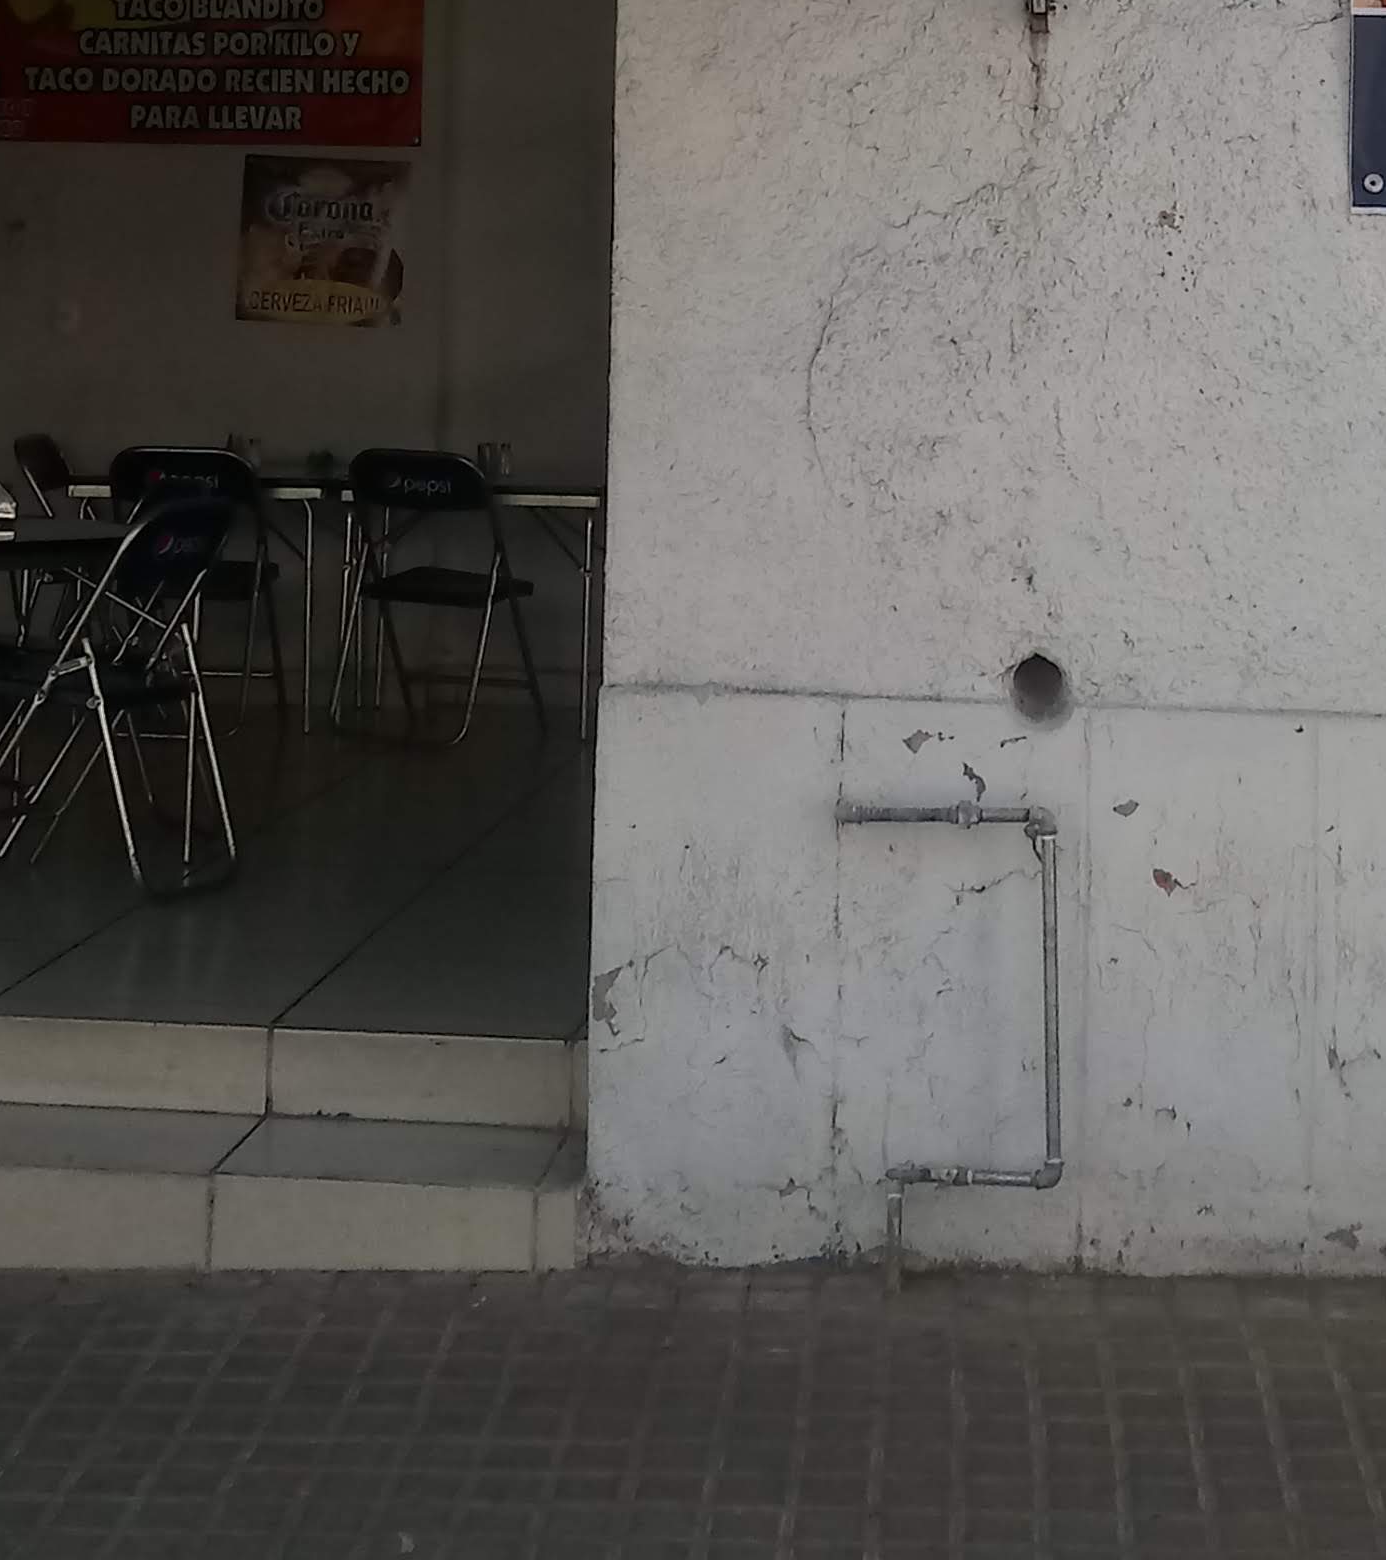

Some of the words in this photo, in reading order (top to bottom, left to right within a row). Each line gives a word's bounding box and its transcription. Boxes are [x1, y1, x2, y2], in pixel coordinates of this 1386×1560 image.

[78, 29, 206, 58] CARNITAS
[213, 30, 271, 57] POR
[274, 29, 337, 57] KILO
[340, 31, 360, 58] Y
[24, 65, 95, 93] TACO
[101, 67, 219, 94] DORADO
[224, 67, 313, 95] RECIEN
[321, 68, 411, 96] HECHO
[129, 104, 200, 130] PARA
[207, 104, 302, 132] LLEVAR
